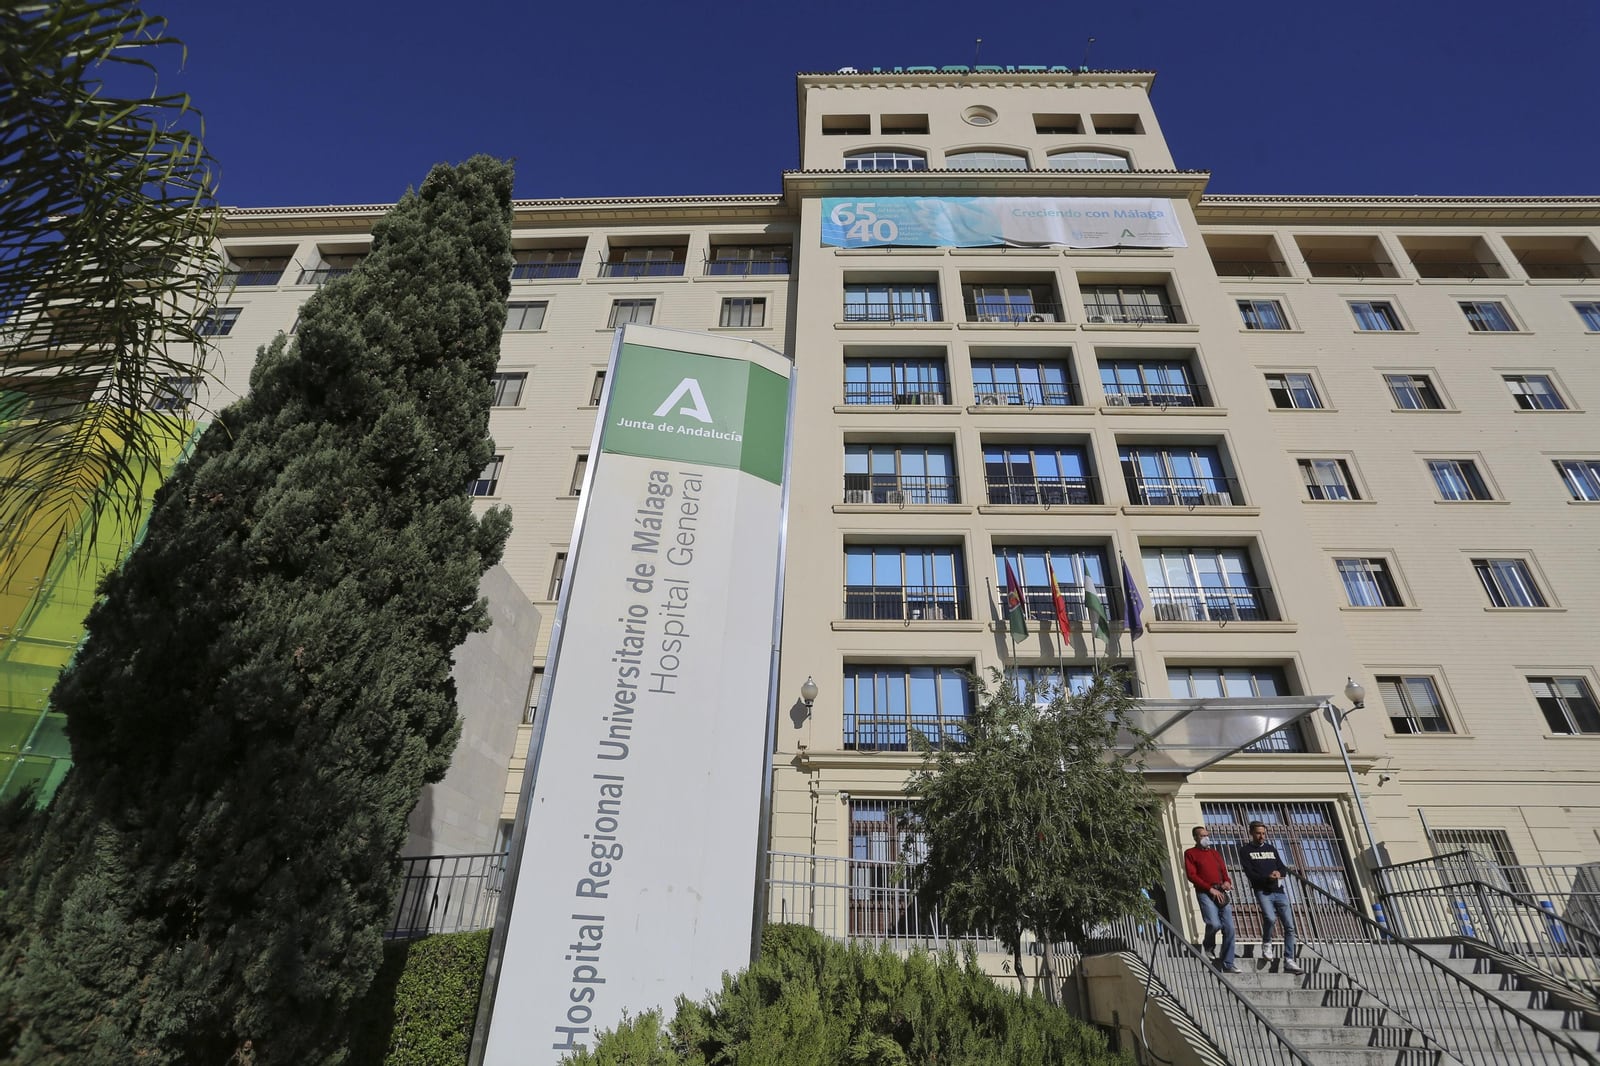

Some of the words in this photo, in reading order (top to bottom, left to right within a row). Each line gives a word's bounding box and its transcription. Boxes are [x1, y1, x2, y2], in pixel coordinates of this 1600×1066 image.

[831, 202, 877, 226] 65
[846, 219, 899, 242] 40
[1012, 208, 1081, 218] Creciendo
[1085, 209, 1110, 218] con
[1113, 208, 1165, 219] Málaga
[616, 417, 655, 430] Junta
[657, 422, 674, 433] de
[676, 425, 743, 442] Andalucía
[631, 470, 673, 554] Málaga
[666, 471, 704, 566] General
[626, 563, 656, 594] de
[648, 578, 690, 695] Hospital
[597, 604, 649, 761] Universitario
[575, 774, 625, 899] Regional
[550, 914, 606, 1051] Hospital
